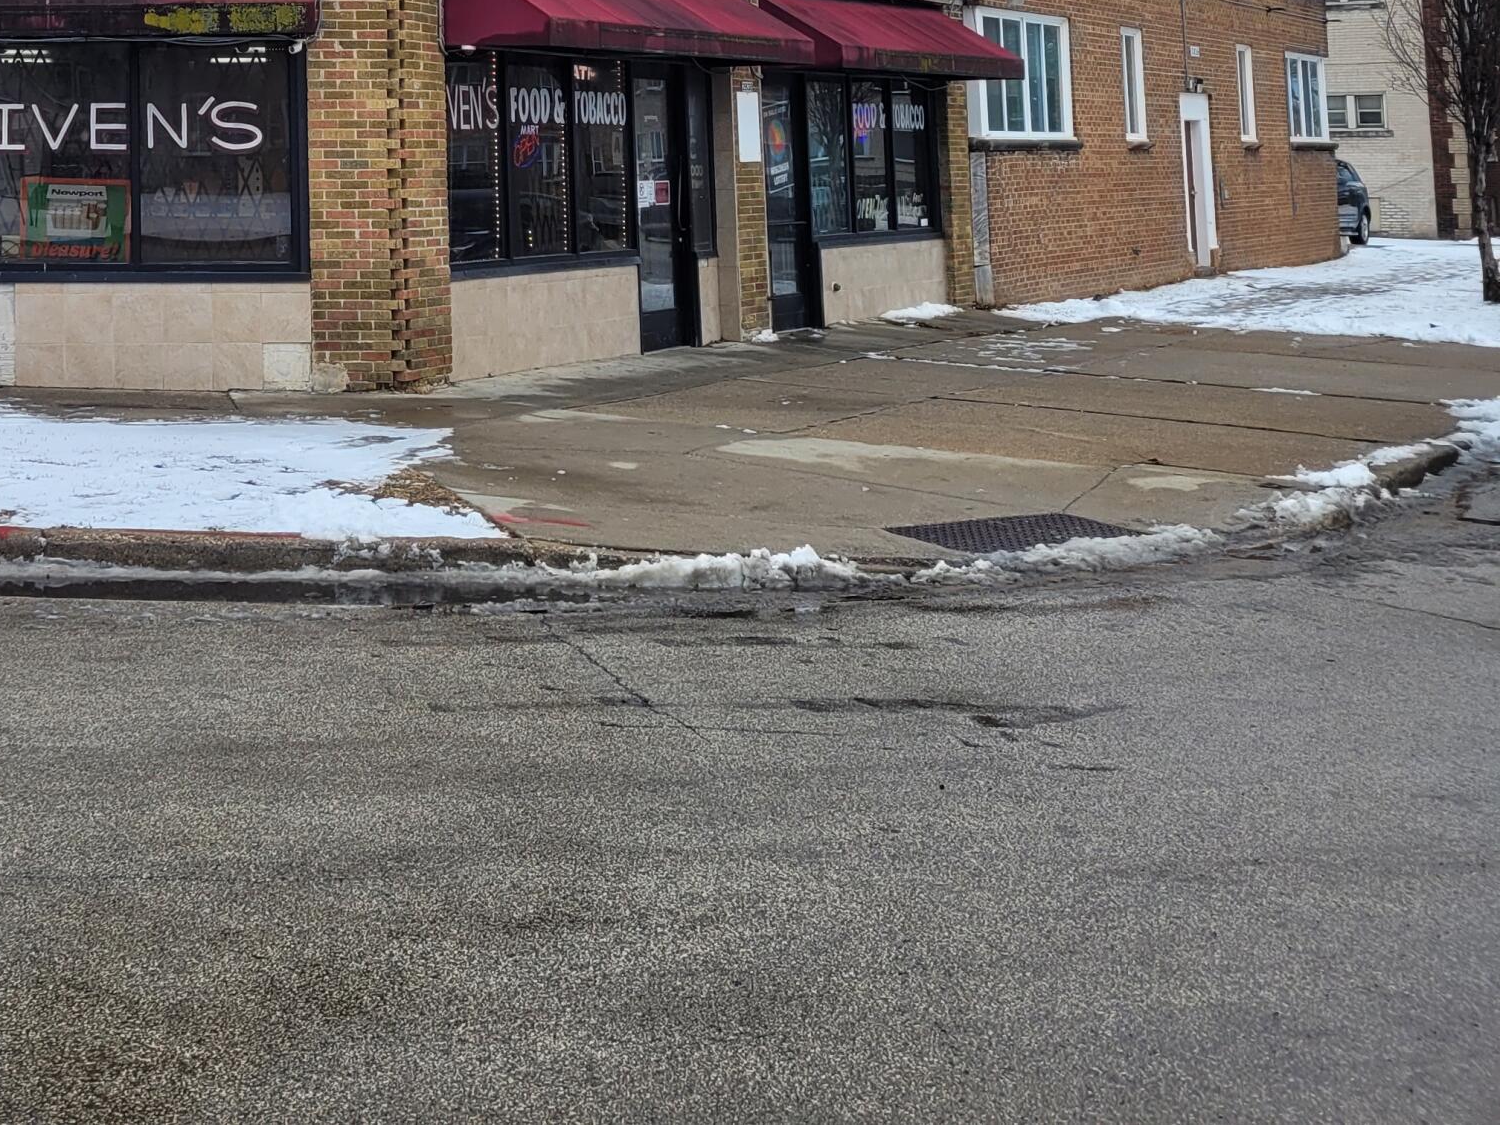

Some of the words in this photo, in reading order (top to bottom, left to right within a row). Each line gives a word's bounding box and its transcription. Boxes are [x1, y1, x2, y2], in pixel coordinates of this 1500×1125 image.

[446, 77, 500, 130] VEN'S
[509, 86, 551, 124] FOOD
[553, 87, 566, 124] &
[574, 90, 627, 126] TOBACCO
[852, 102, 877, 130] FOOD
[51, 188, 104, 197] Newport
